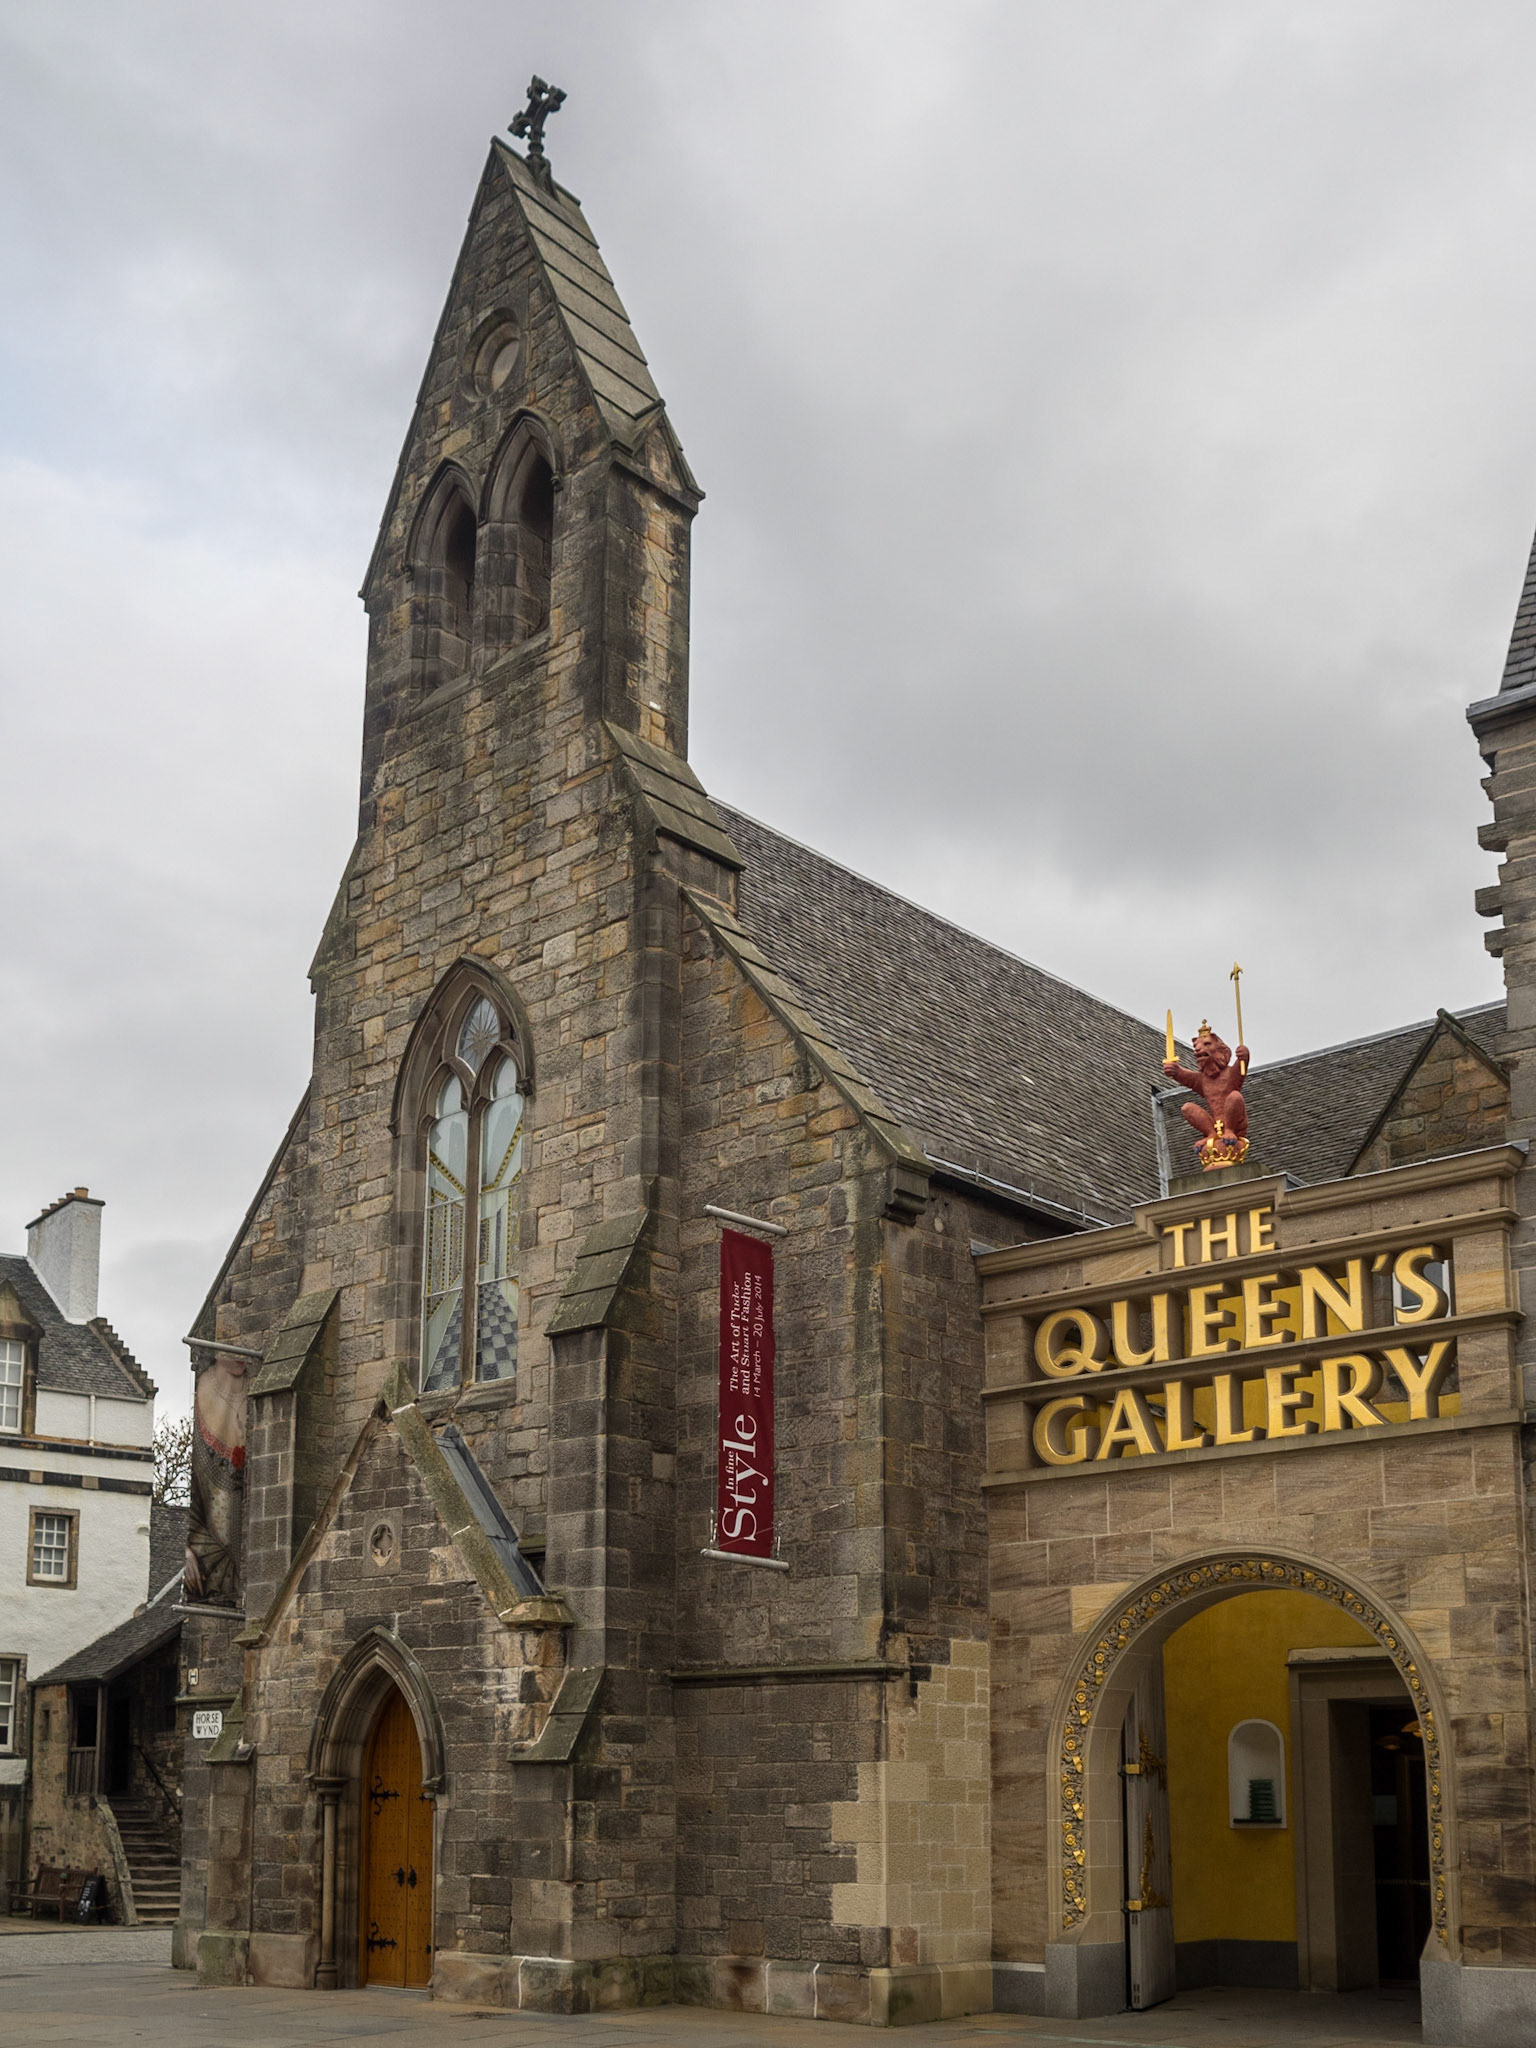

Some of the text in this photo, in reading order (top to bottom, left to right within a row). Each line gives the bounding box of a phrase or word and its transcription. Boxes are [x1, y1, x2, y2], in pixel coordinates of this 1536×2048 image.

[1163, 1206, 1277, 1268] THE
[754, 1275, 762, 1299] 2014
[753, 1323, 763, 1337] 20
[754, 1302, 765, 1322] July
[1034, 1244, 1448, 1379] QUEEN'S
[730, 1281, 740, 1391] The Art of Tudor
[740, 1271, 751, 1394] and Stuart Fashion
[753, 1350, 761, 1384] March
[753, 1386, 761, 1397] 14
[1033, 1341, 1455, 1466] GALLERY
[721, 1414, 769, 1541] Style
[725, 1450, 735, 1490] In fine
[195, 1713, 219, 1724] HORSE
[196, 1725, 219, 1736] WYND
